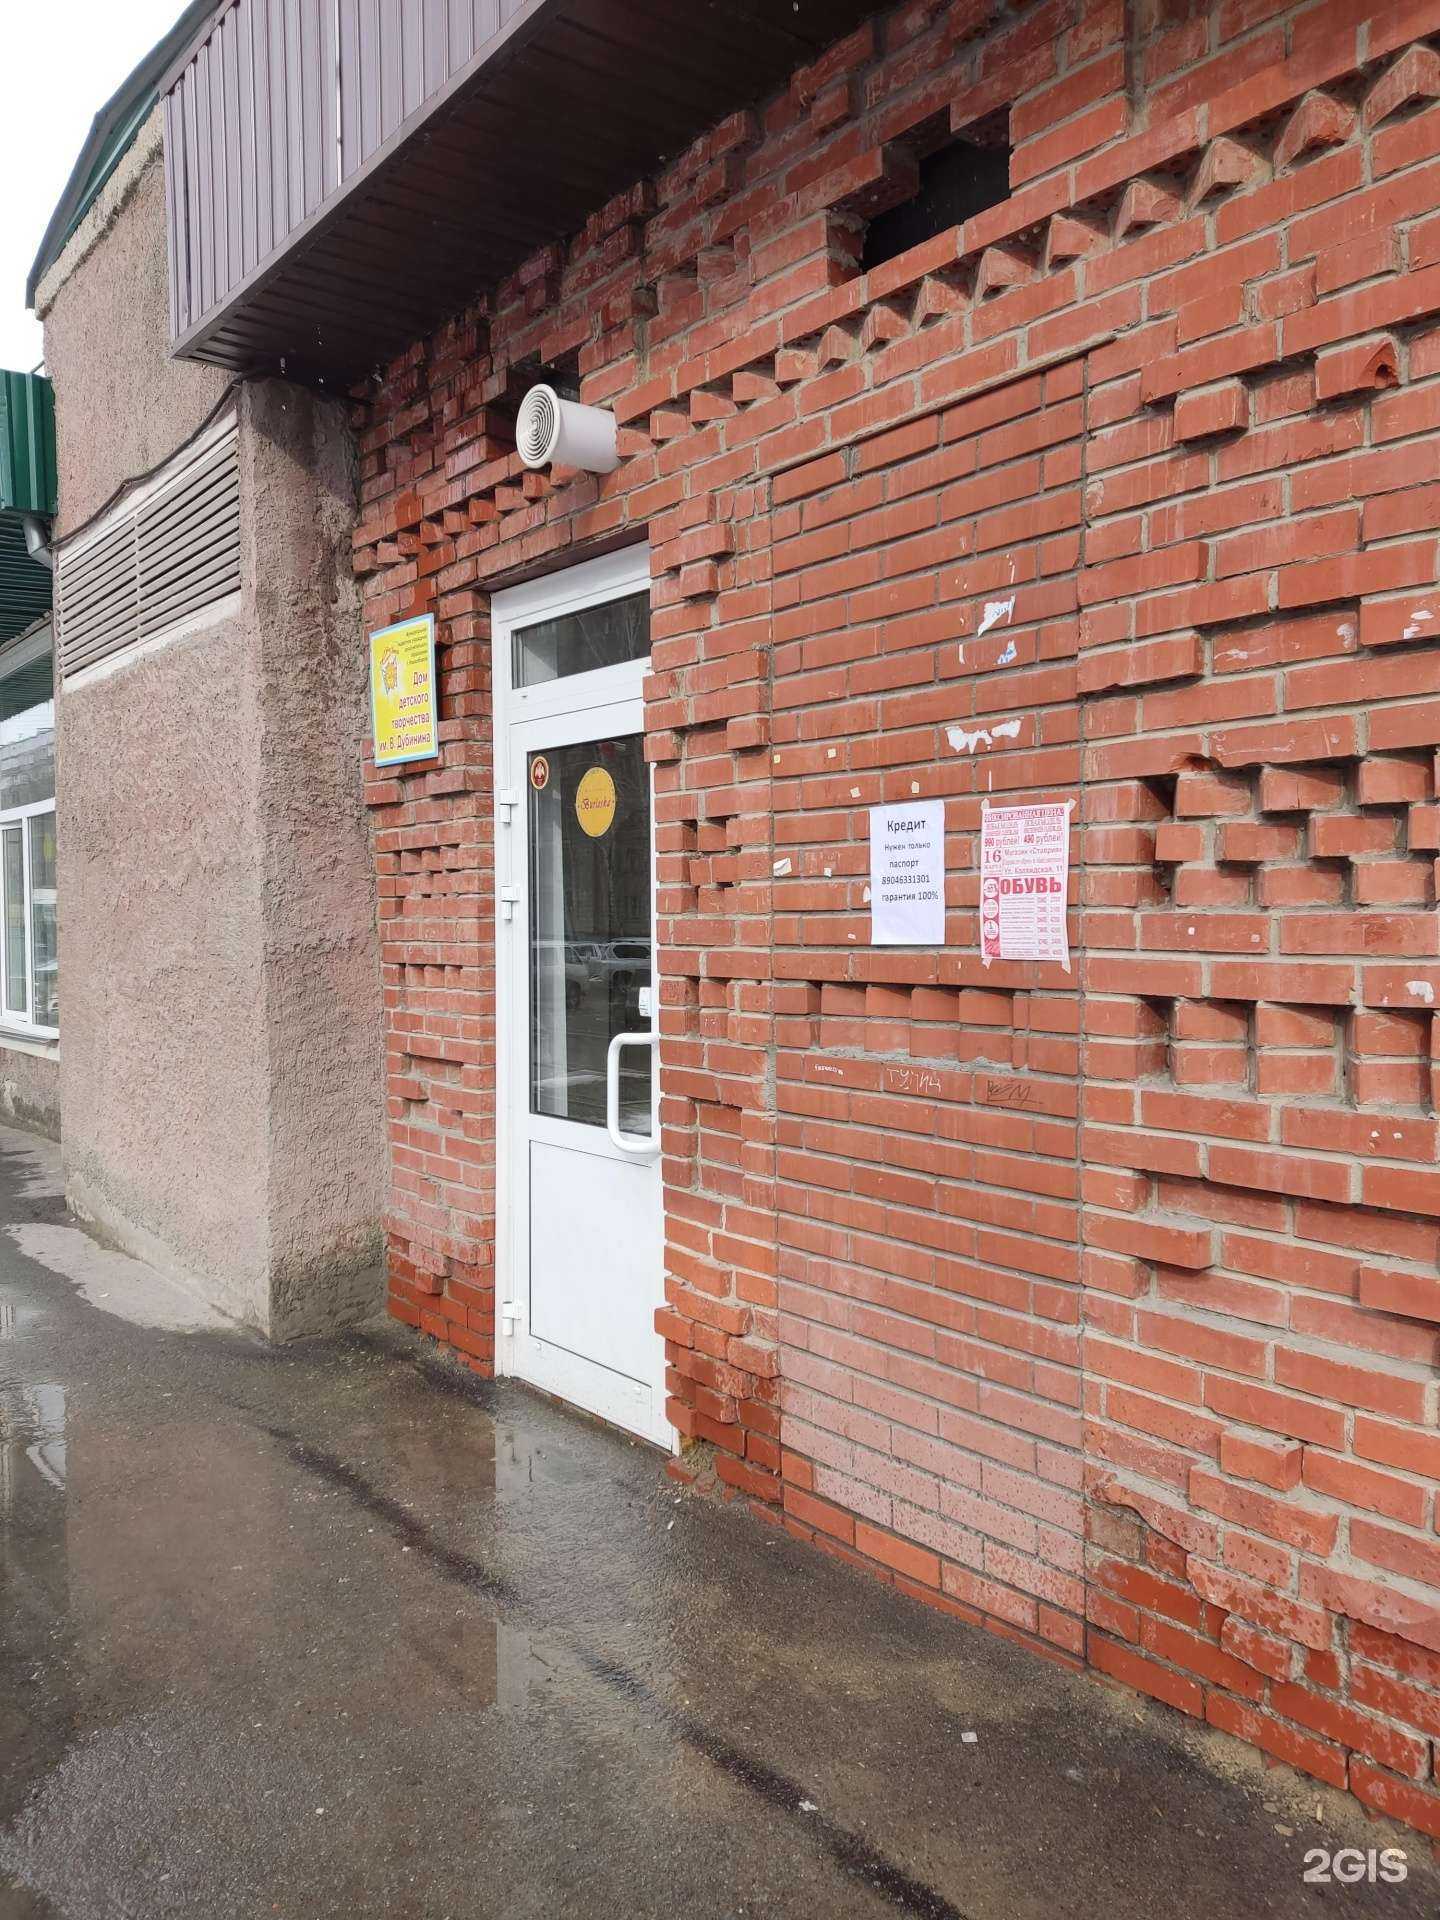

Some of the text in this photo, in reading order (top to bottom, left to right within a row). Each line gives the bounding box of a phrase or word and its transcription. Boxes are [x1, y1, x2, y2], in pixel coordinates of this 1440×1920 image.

[413, 672, 428, 687] Дом
[399, 693, 429, 710] детского
[392, 713, 430, 730] творчества
[397, 733, 431, 750] Дубинина
[887, 820, 927, 834] Кредит
[884, 842, 931, 852] Нужен только
[984, 849, 1002, 863] 16
[889, 860, 920, 868] паспорт
[1000, 877, 1062, 894] ОБУВЬ
[881, 891, 939, 903] гарантия 100%
